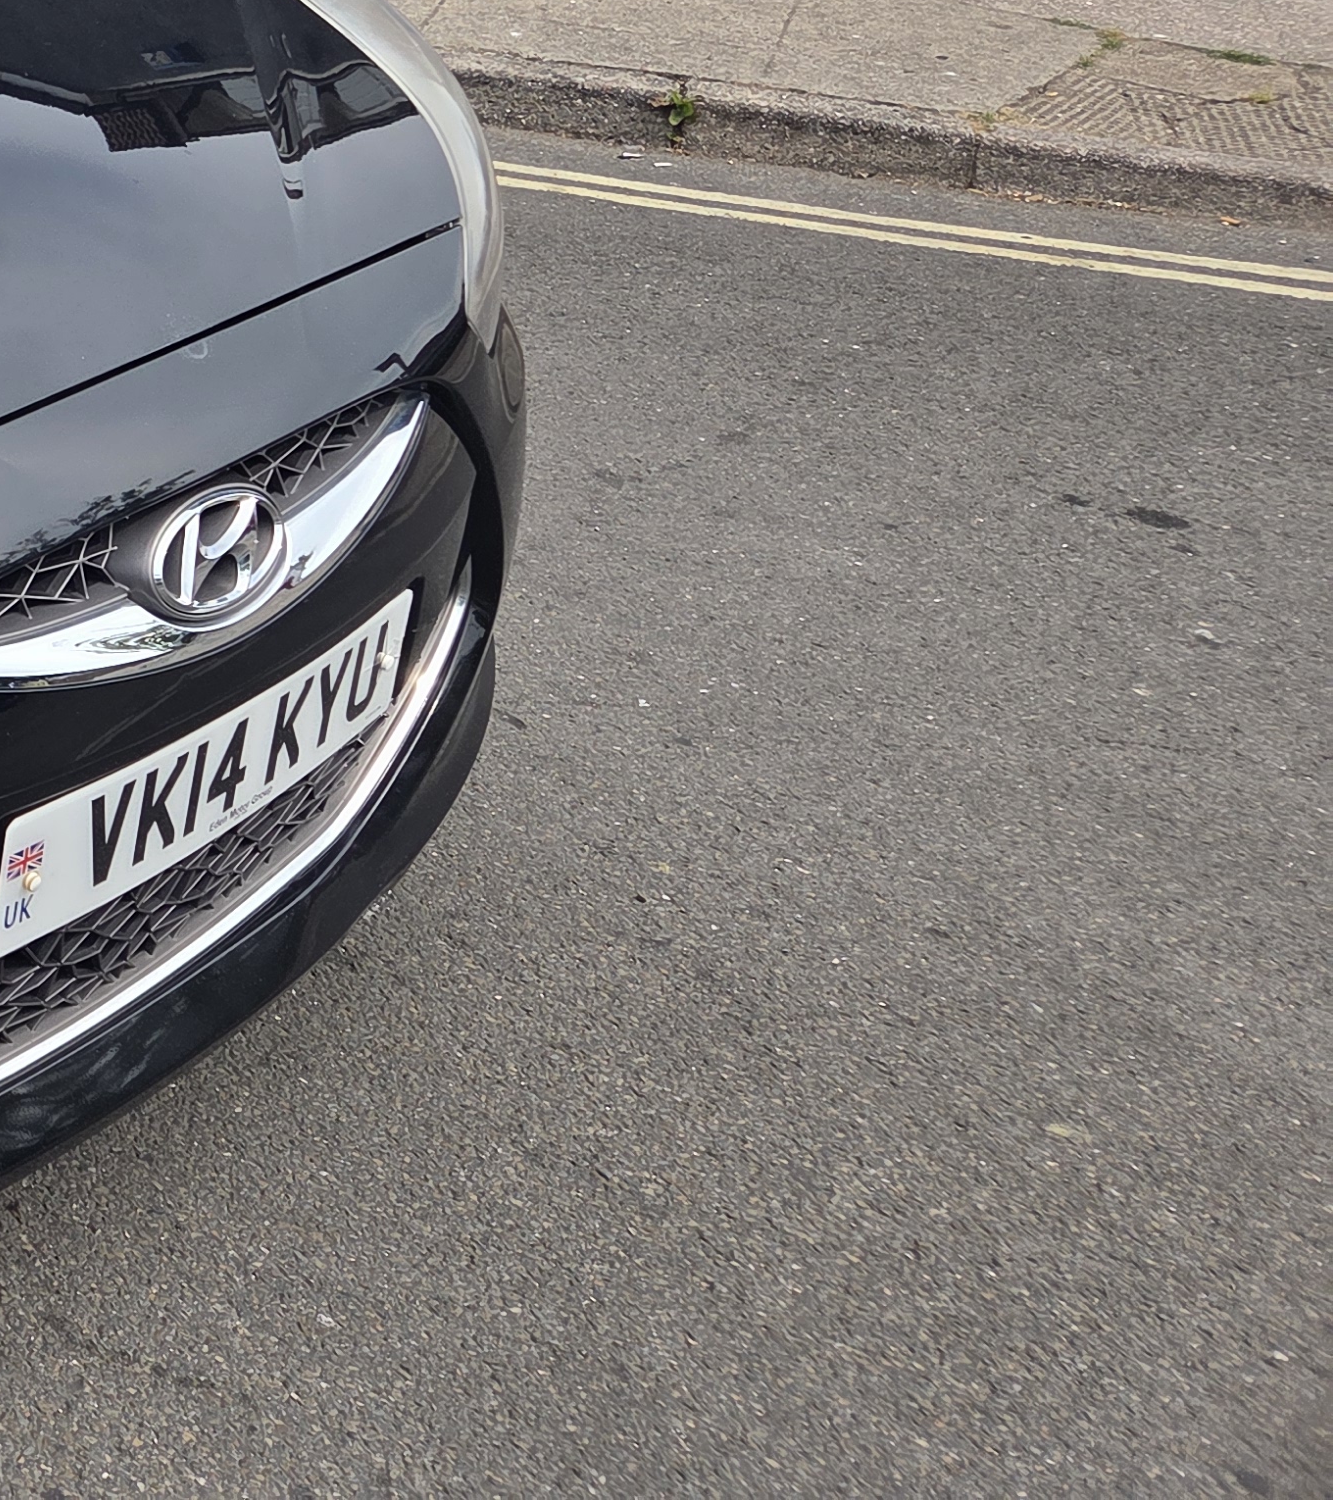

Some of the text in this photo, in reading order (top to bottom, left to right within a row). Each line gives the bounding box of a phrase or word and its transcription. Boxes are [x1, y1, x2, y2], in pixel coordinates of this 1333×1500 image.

[91, 620, 389, 887] VK14 KYU
[4, 895, 33, 930] UK
